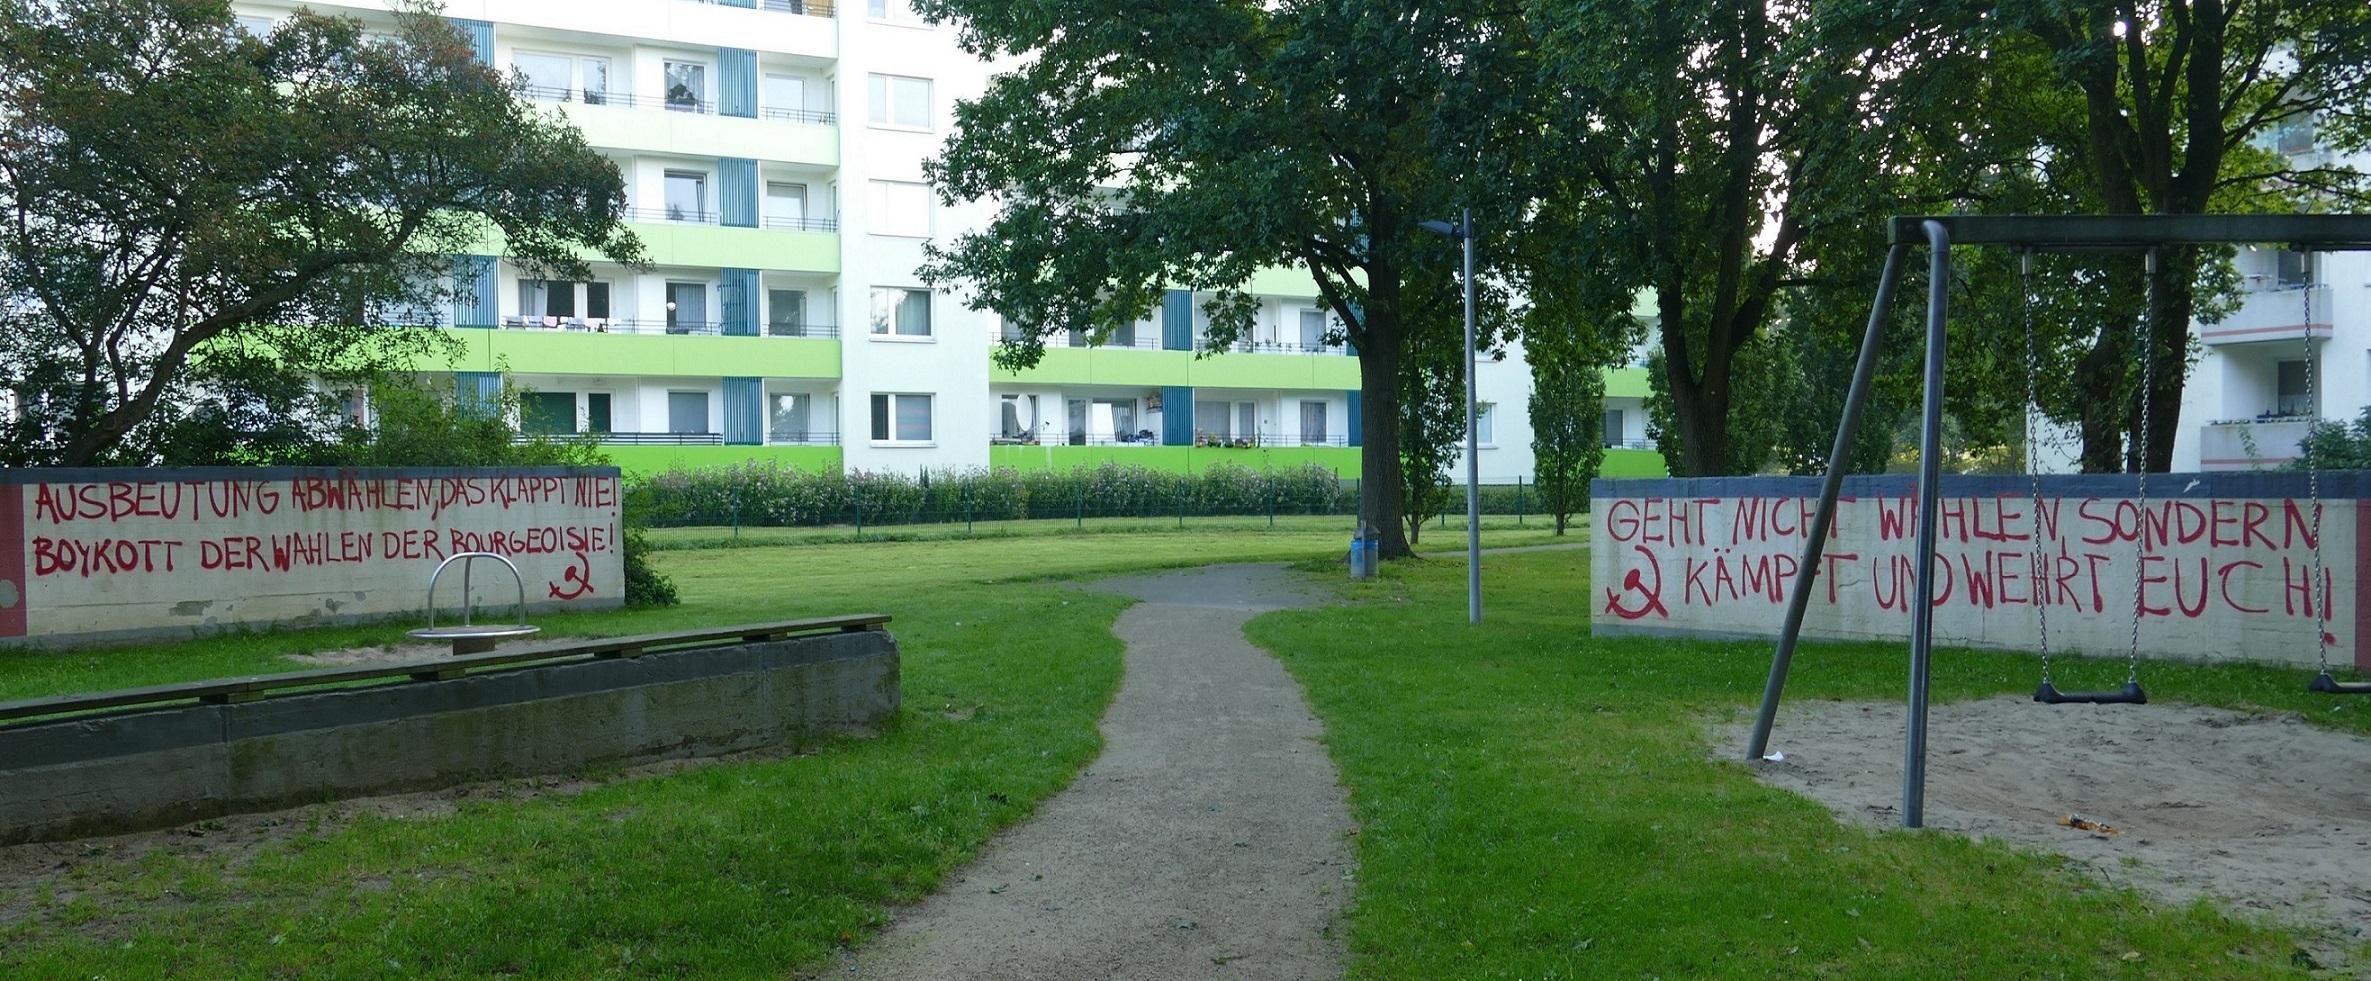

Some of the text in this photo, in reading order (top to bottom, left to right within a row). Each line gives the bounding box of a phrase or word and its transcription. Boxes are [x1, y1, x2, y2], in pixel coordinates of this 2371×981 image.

[35, 479, 280, 524] AUSBEUTUNG
[489, 474, 568, 510] KLAPPT
[575, 474, 617, 517] NIE!
[1607, 496, 1721, 547] GEHT
[2078, 496, 2323, 552] SONDERN
[32, 522, 614, 578] BOYKOTT DER WAHLEN DER BOURGEOISIE!
[1685, 547, 1858, 606] KÄMPT
[1961, 550, 2110, 613] WEHRT
[2136, 556, 2336, 645] EUCH!
